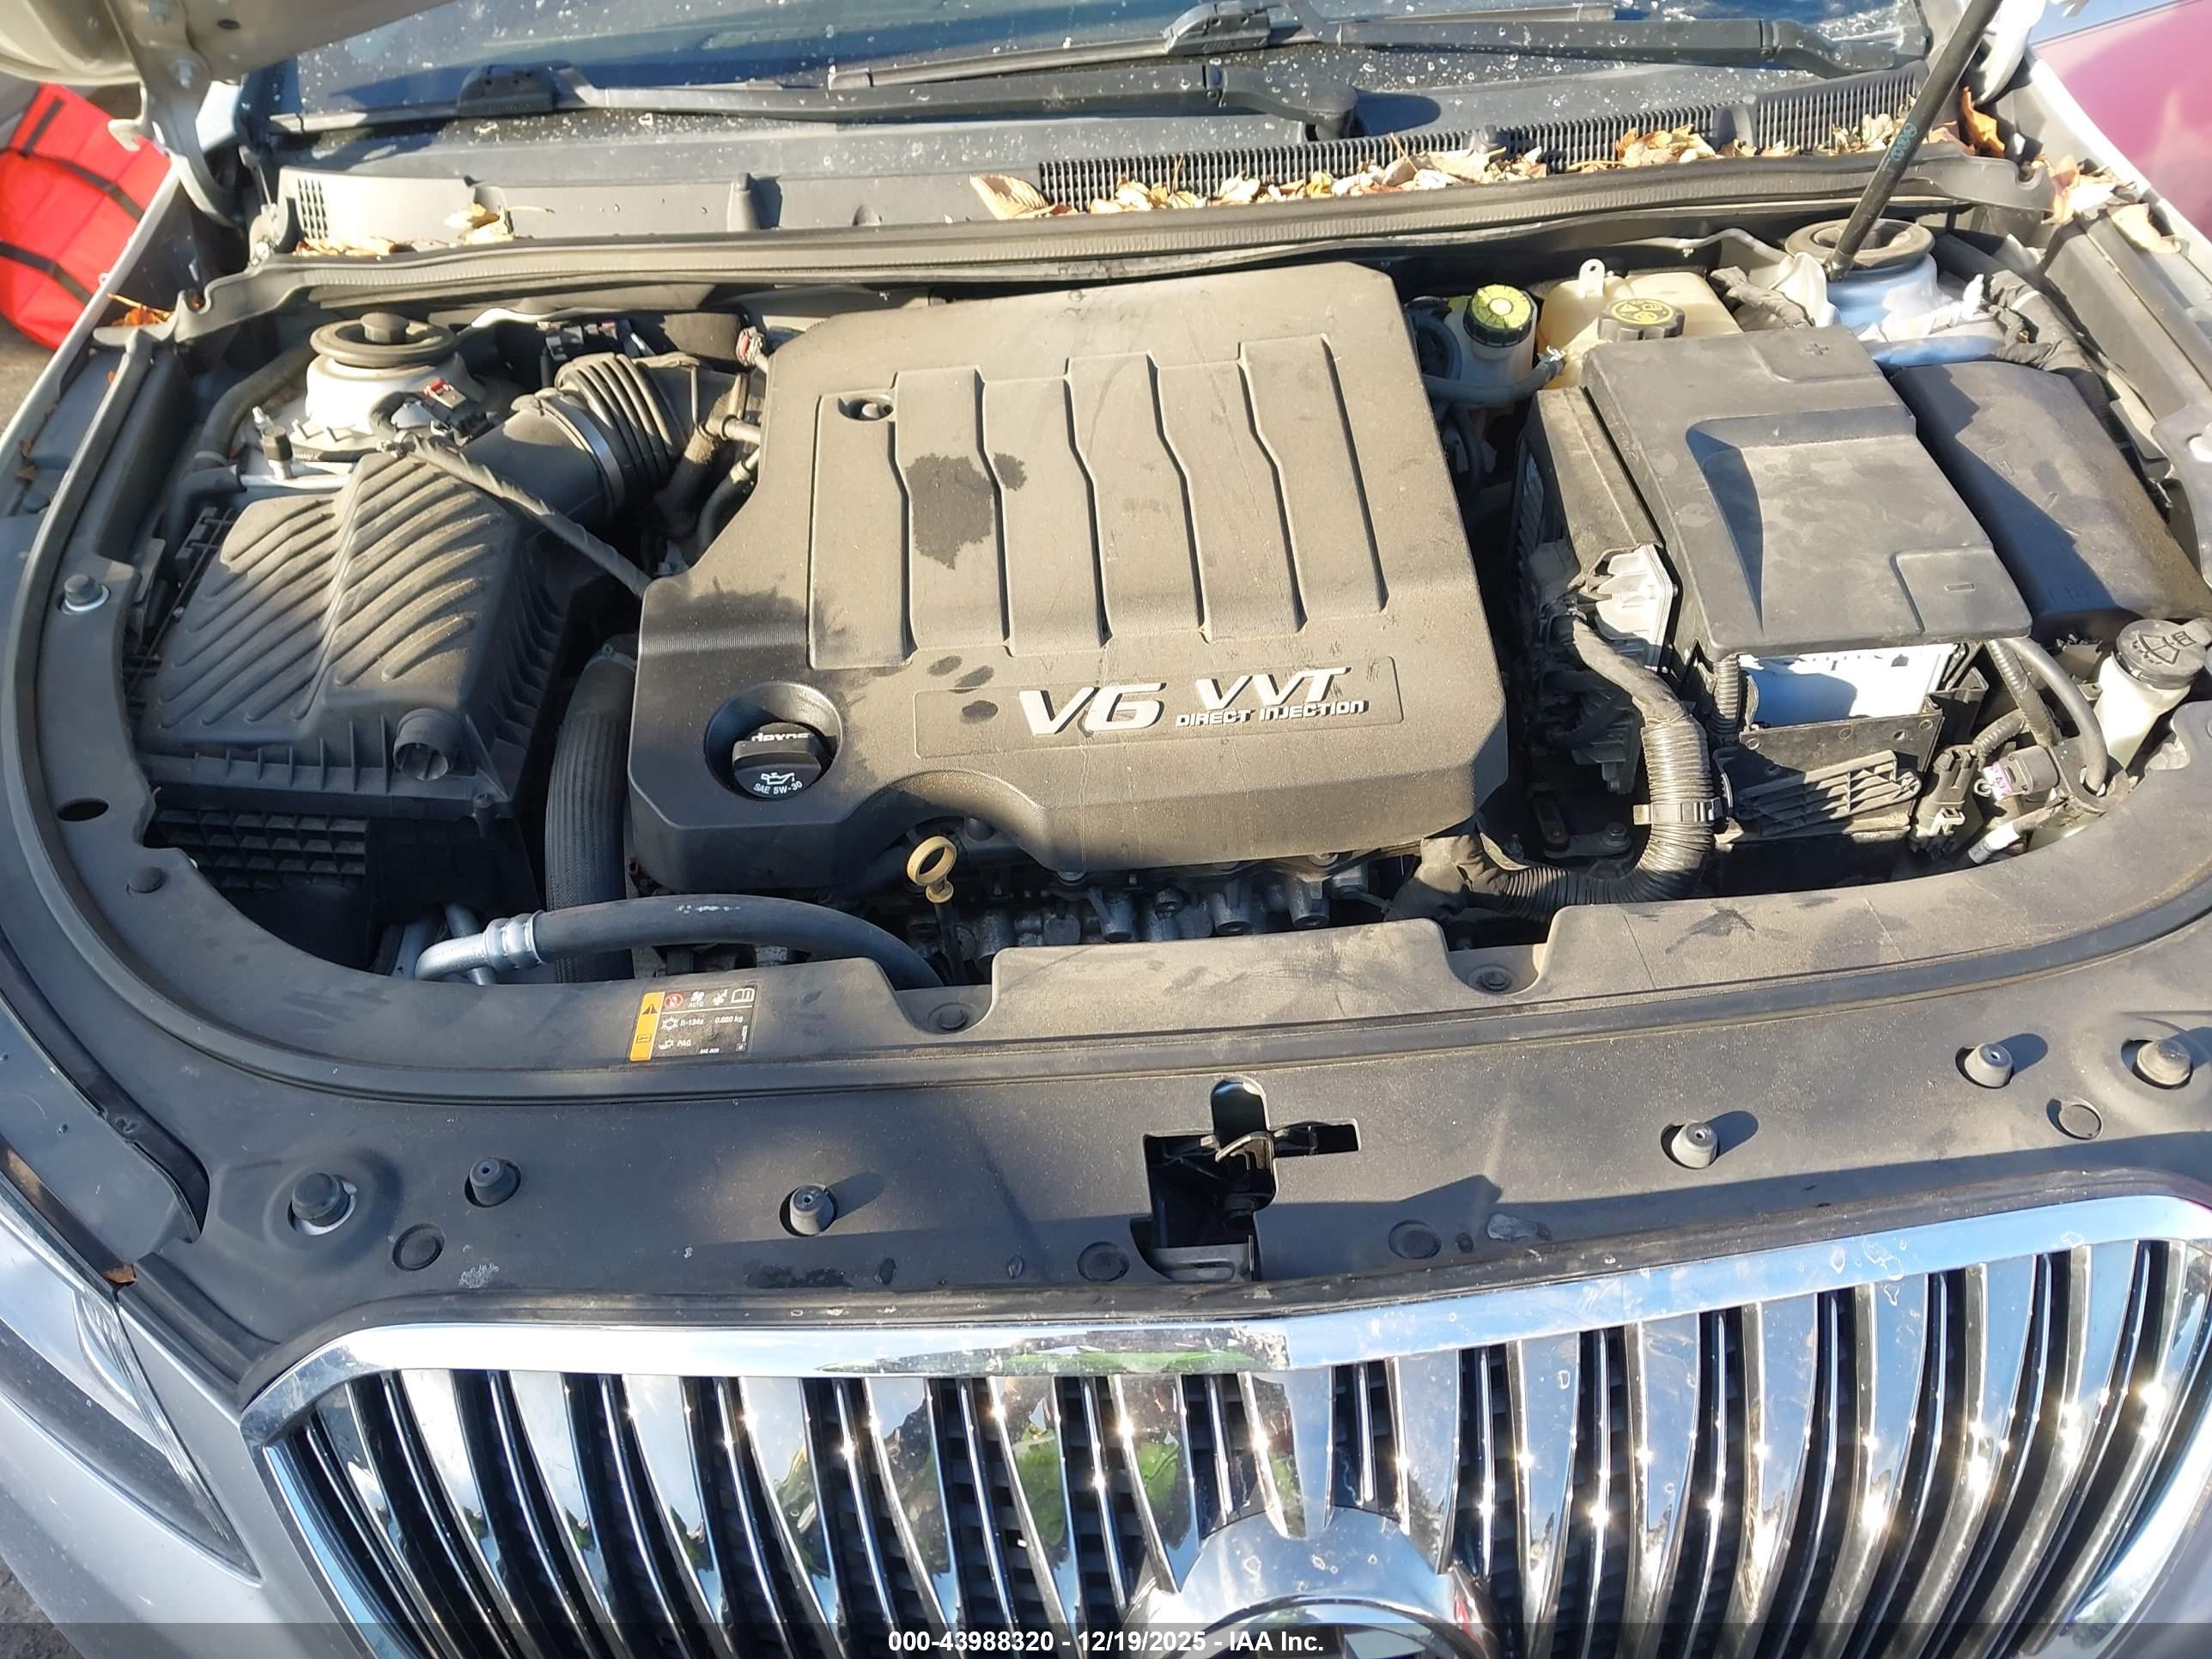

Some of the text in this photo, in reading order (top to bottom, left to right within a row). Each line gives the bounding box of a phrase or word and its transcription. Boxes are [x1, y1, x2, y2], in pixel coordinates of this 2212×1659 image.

[1018, 666, 1352, 736] V6 VVT
[1176, 700, 1370, 726] DIRECT INJECTION
[753, 781, 803, 795] SAE 5W-30
